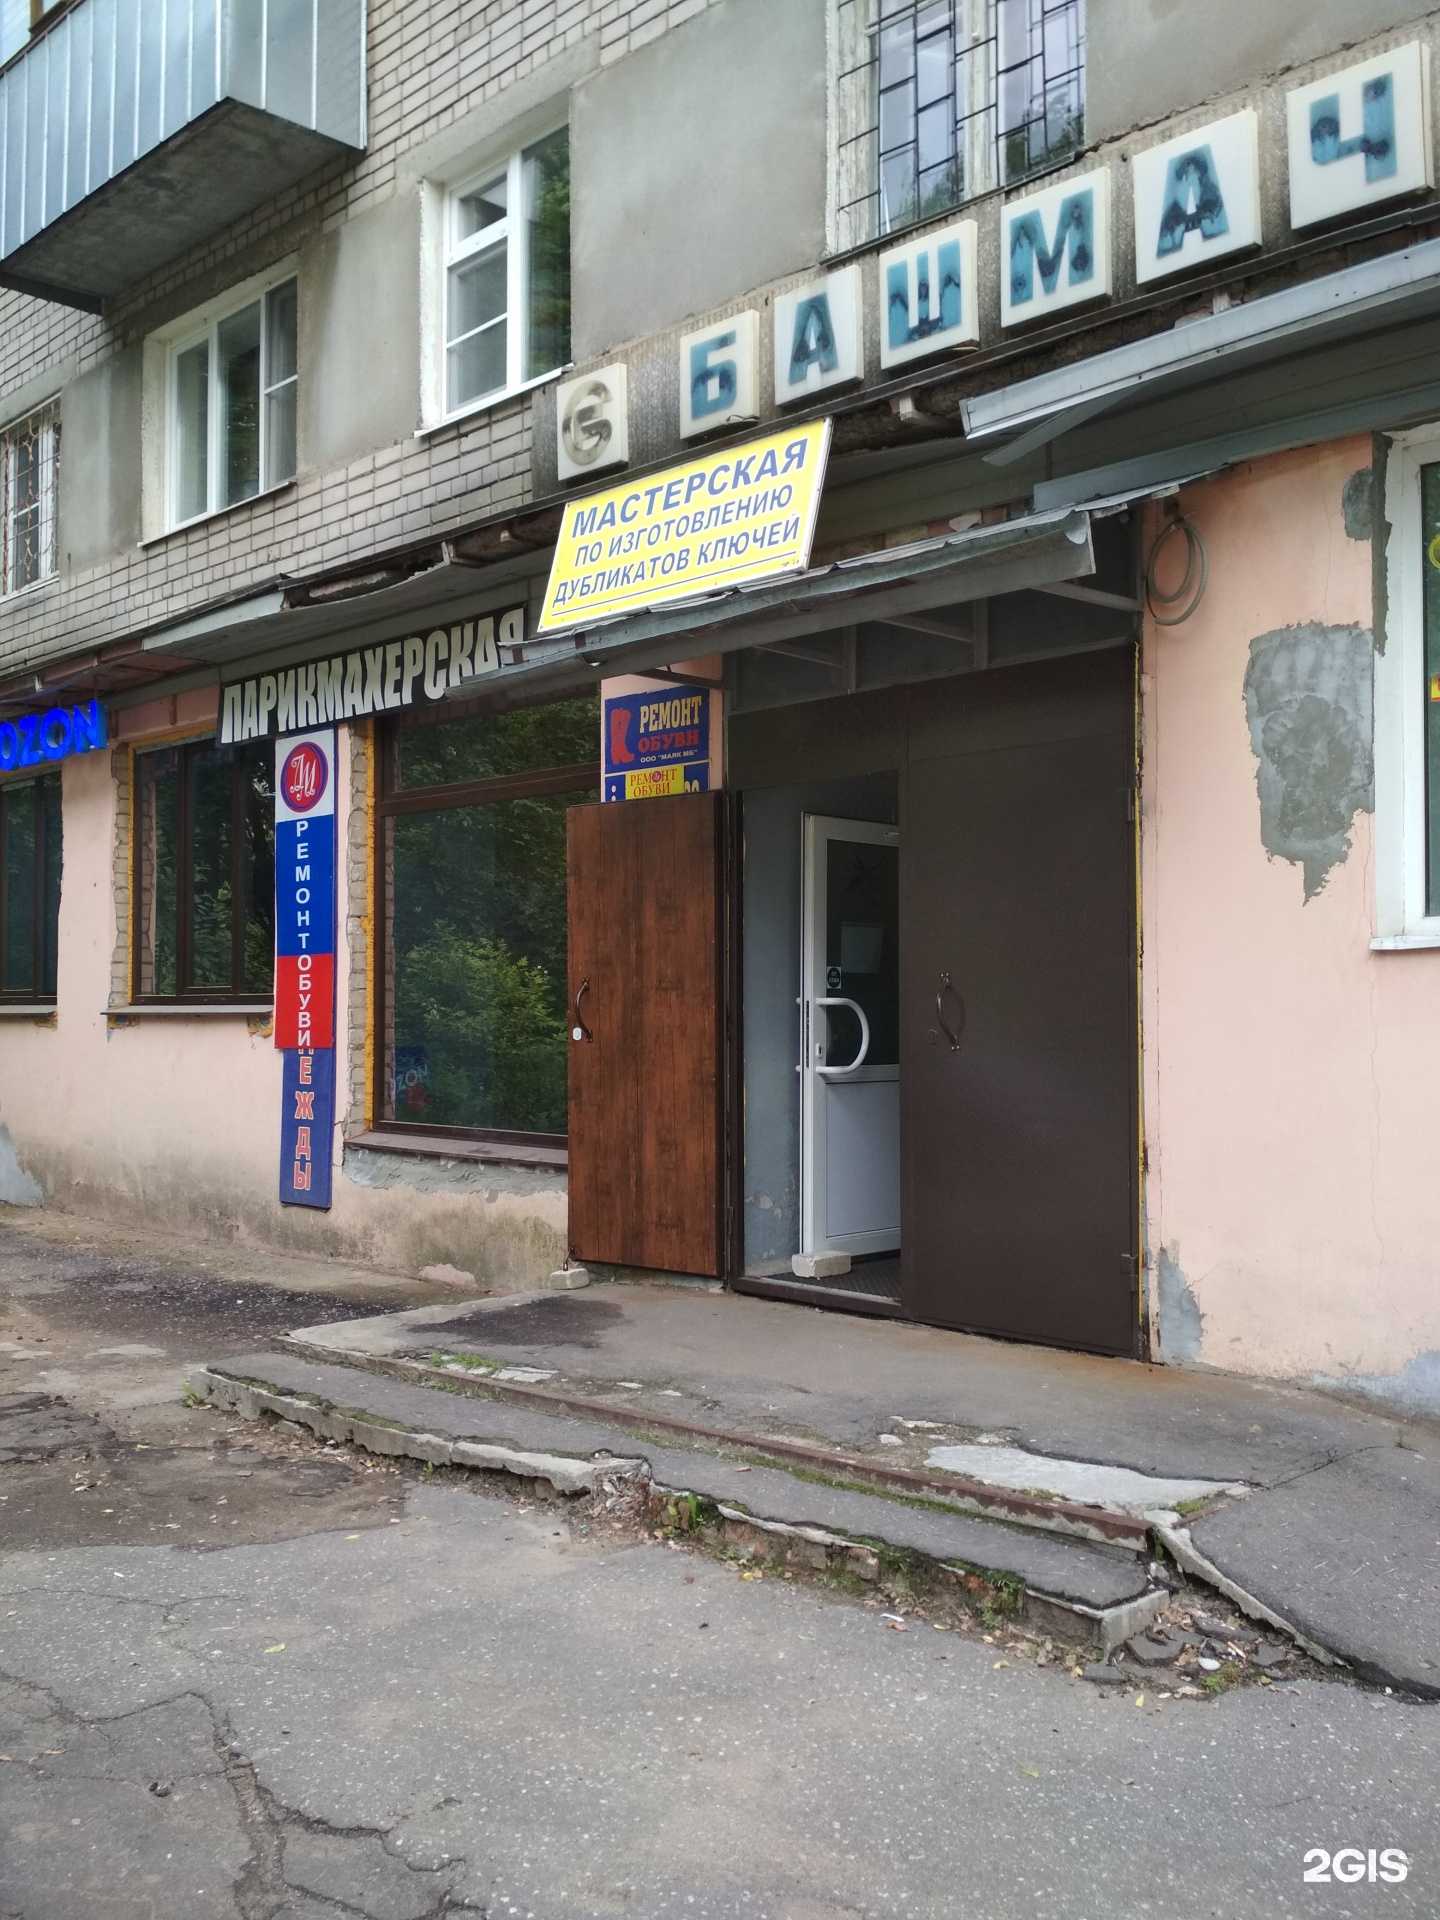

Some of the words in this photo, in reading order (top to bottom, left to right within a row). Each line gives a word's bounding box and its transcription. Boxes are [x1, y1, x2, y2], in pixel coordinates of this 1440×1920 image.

[690, 70, 1397, 420] БАШМАЧ
[571, 438, 808, 538] МАСТЕРСКАЯ
[574, 541, 602, 567] ПО
[608, 484, 793, 558] ИЗГОТОВЛЕНИЮ
[552, 547, 690, 608] ДУБЛИКАТОВ
[0, 699, 100, 772] OZON
[638, 729, 700, 753] ОБУВИ
[639, 696, 702, 733] РЕМОНТ
[633, 781, 671, 798] ОБУВИ
[640, 755, 657, 763] ООО
[295, 820, 311, 949] РЕМОНТ
[297, 954, 312, 1047] ОБУВИ
[293, 1049, 315, 1191] ЕЖДЫ
